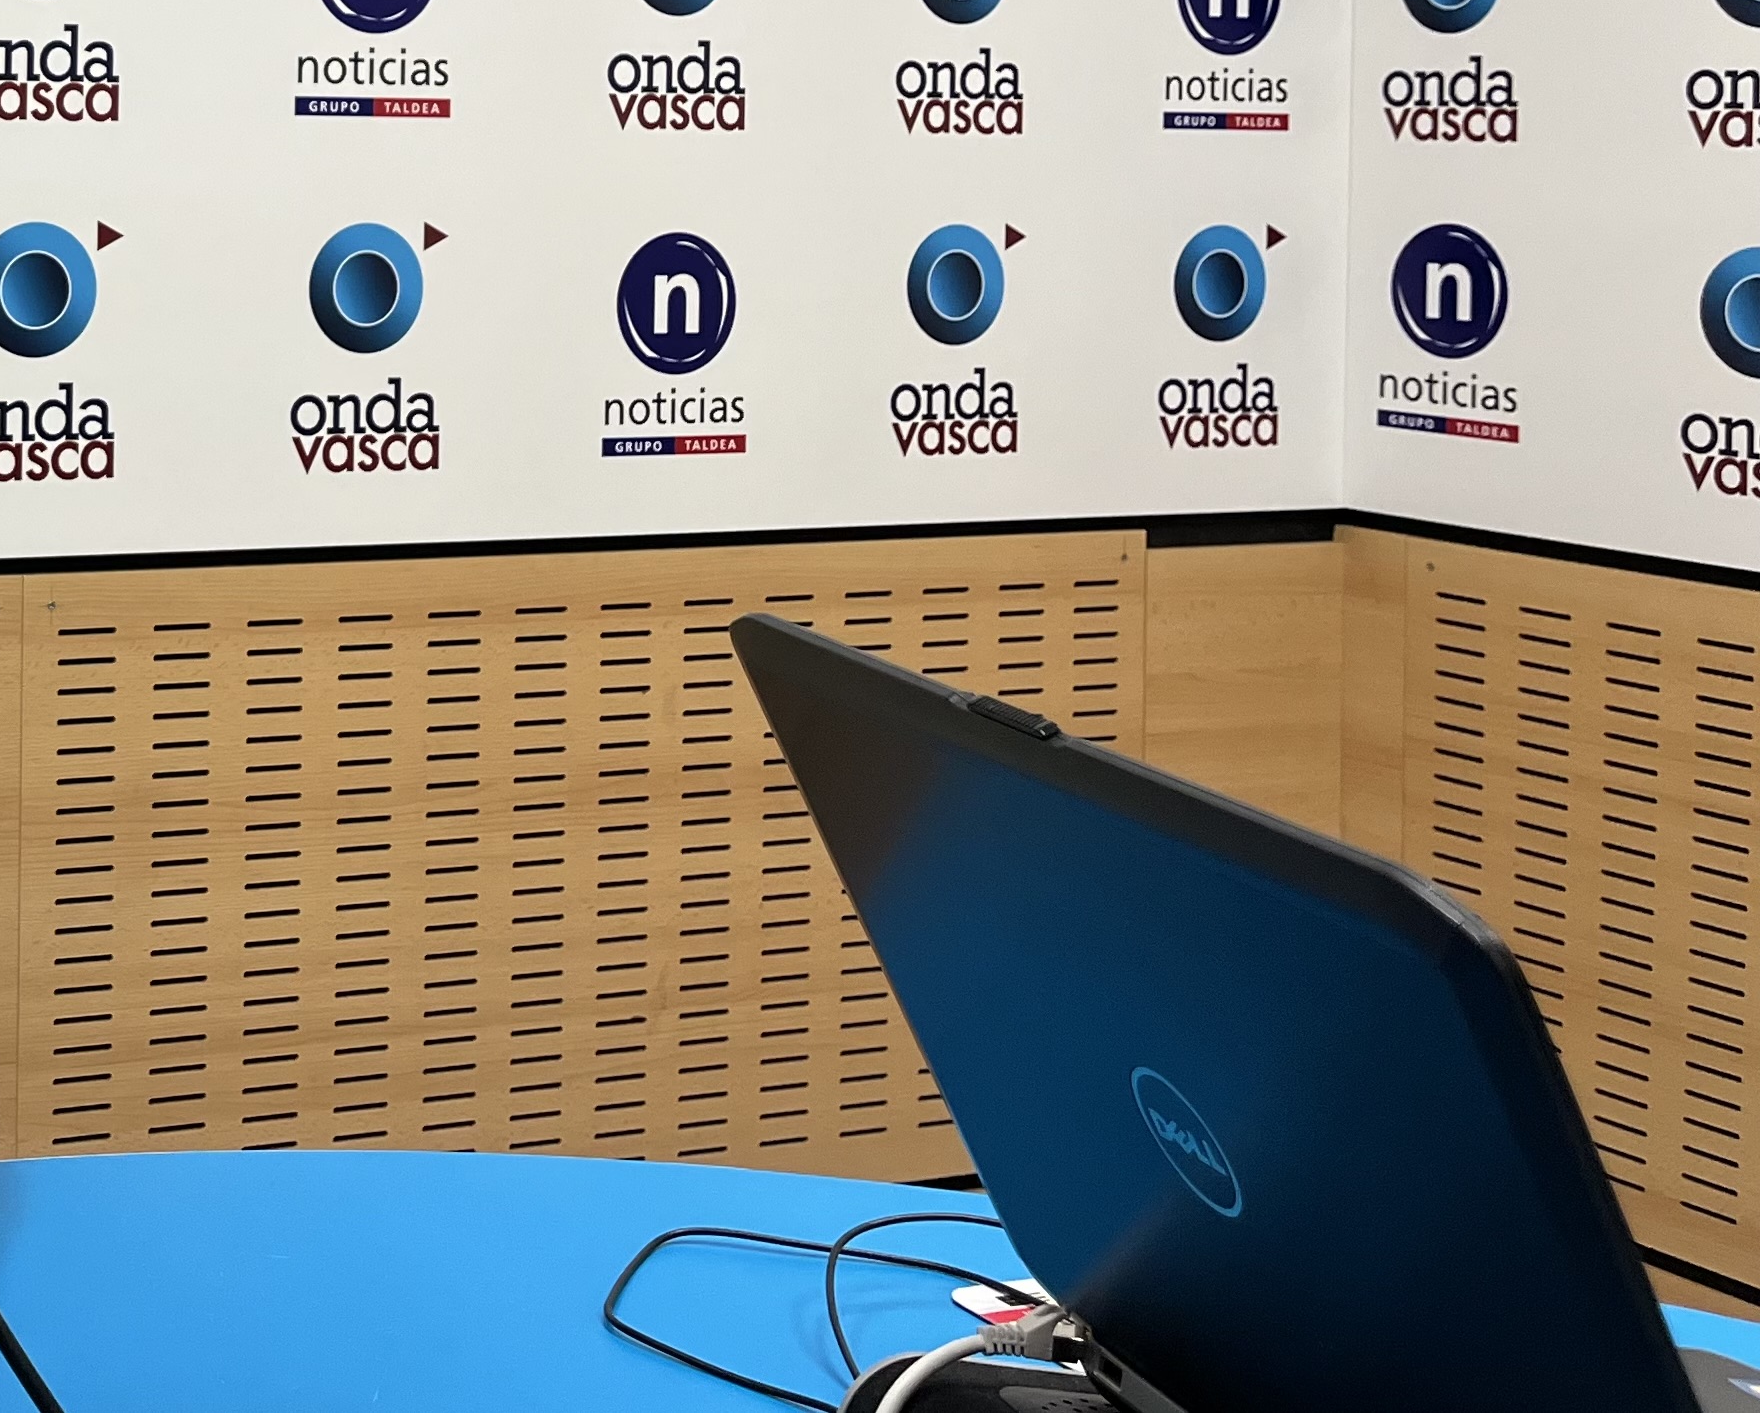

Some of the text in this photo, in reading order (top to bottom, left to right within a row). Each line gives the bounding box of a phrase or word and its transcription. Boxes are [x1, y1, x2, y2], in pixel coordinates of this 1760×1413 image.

[297, 47, 449, 86] noticias
[607, 41, 745, 94] onda
[896, 48, 1023, 101] onda
[1165, 68, 1288, 103] noticias
[1383, 56, 1518, 108] onda
[309, 100, 440, 114] GRUPO TALDEA
[1686, 69, 1760, 109] on
[609, 93, 745, 130] vasca
[897, 98, 1023, 135] vasca
[1174, 115, 1281, 127] GRUPO TALDEA
[1385, 107, 1518, 143] vasca
[1687, 110, 1760, 148] va
[291, 378, 440, 436] onda
[604, 388, 745, 426] noticias
[890, 368, 1018, 421] onda
[1158, 363, 1278, 416] onda
[1378, 371, 1517, 412] noticias
[892, 419, 1018, 457] vasca
[1160, 413, 1279, 449] vasca
[1388, 413, 1510, 438] GRUPO TALDEA
[1681, 413, 1760, 459] on
[292, 433, 440, 474] vasca
[615, 439, 737, 453] GRUPO TALDEA
[1148, 1107, 1228, 1177] DELL
